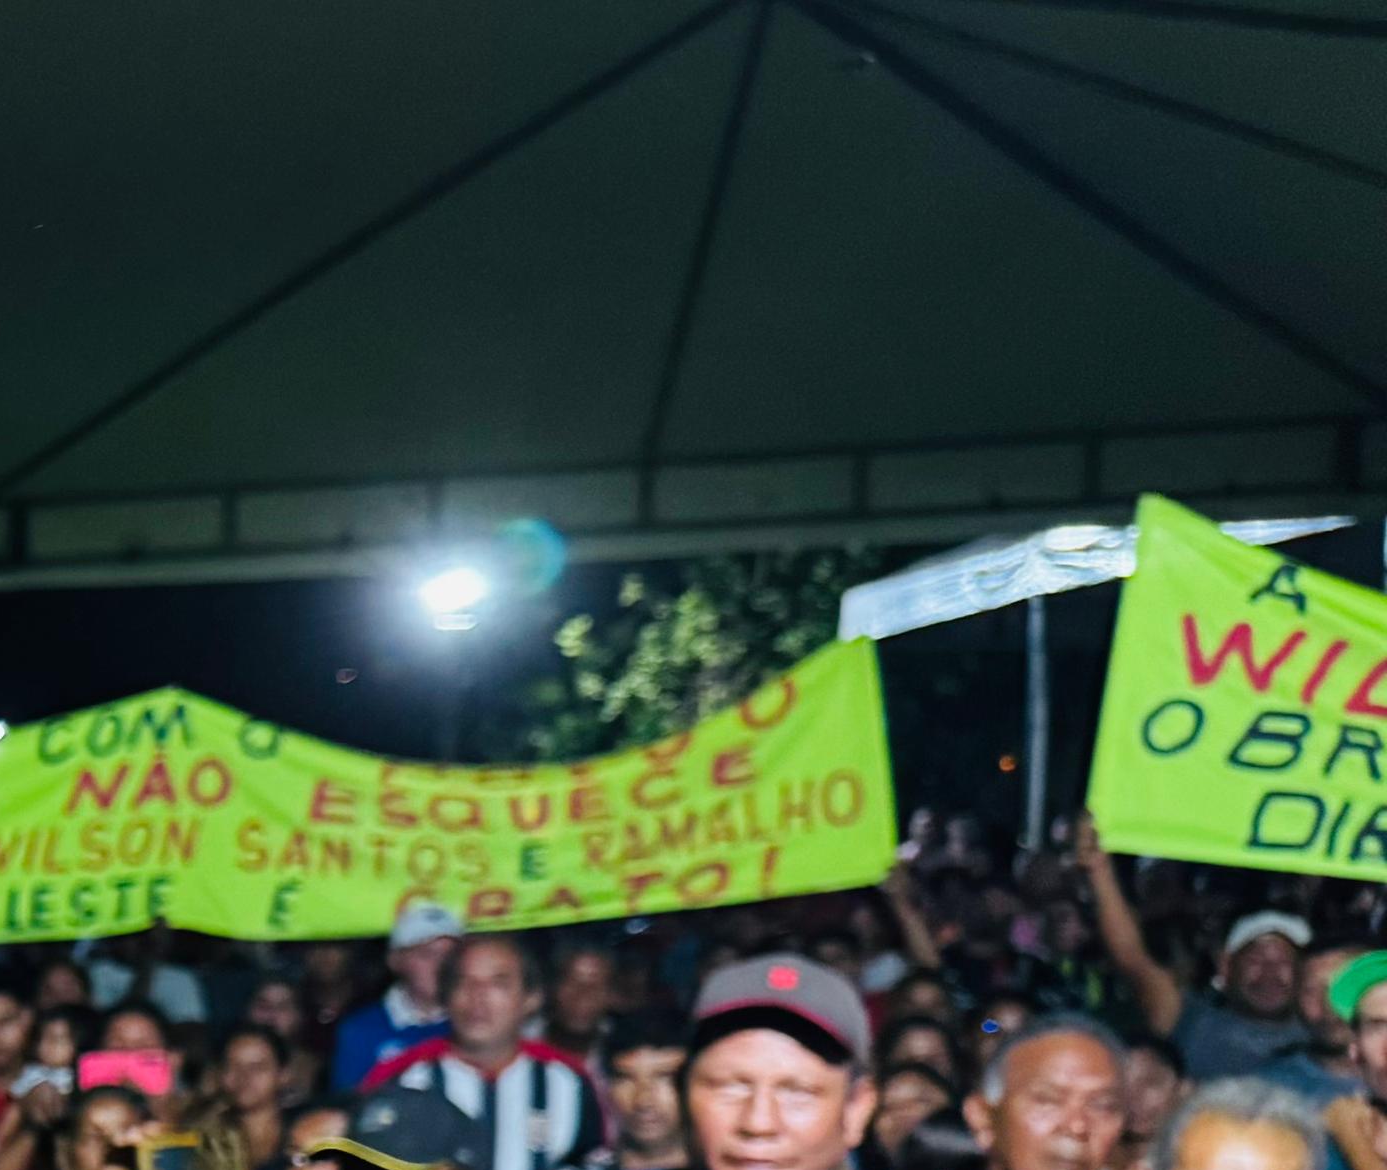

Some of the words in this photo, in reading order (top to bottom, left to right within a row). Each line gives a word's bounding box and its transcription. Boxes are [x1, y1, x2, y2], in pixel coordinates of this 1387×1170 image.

[1249, 563, 1309, 615] A
[37, 704, 194, 764] COM
[239, 717, 283, 760] O
[65, 751, 233, 818] NÃO
[235, 819, 491, 884] SANTOS
[520, 841, 548, 881] E
[584, 769, 864, 872] RAMALHO
